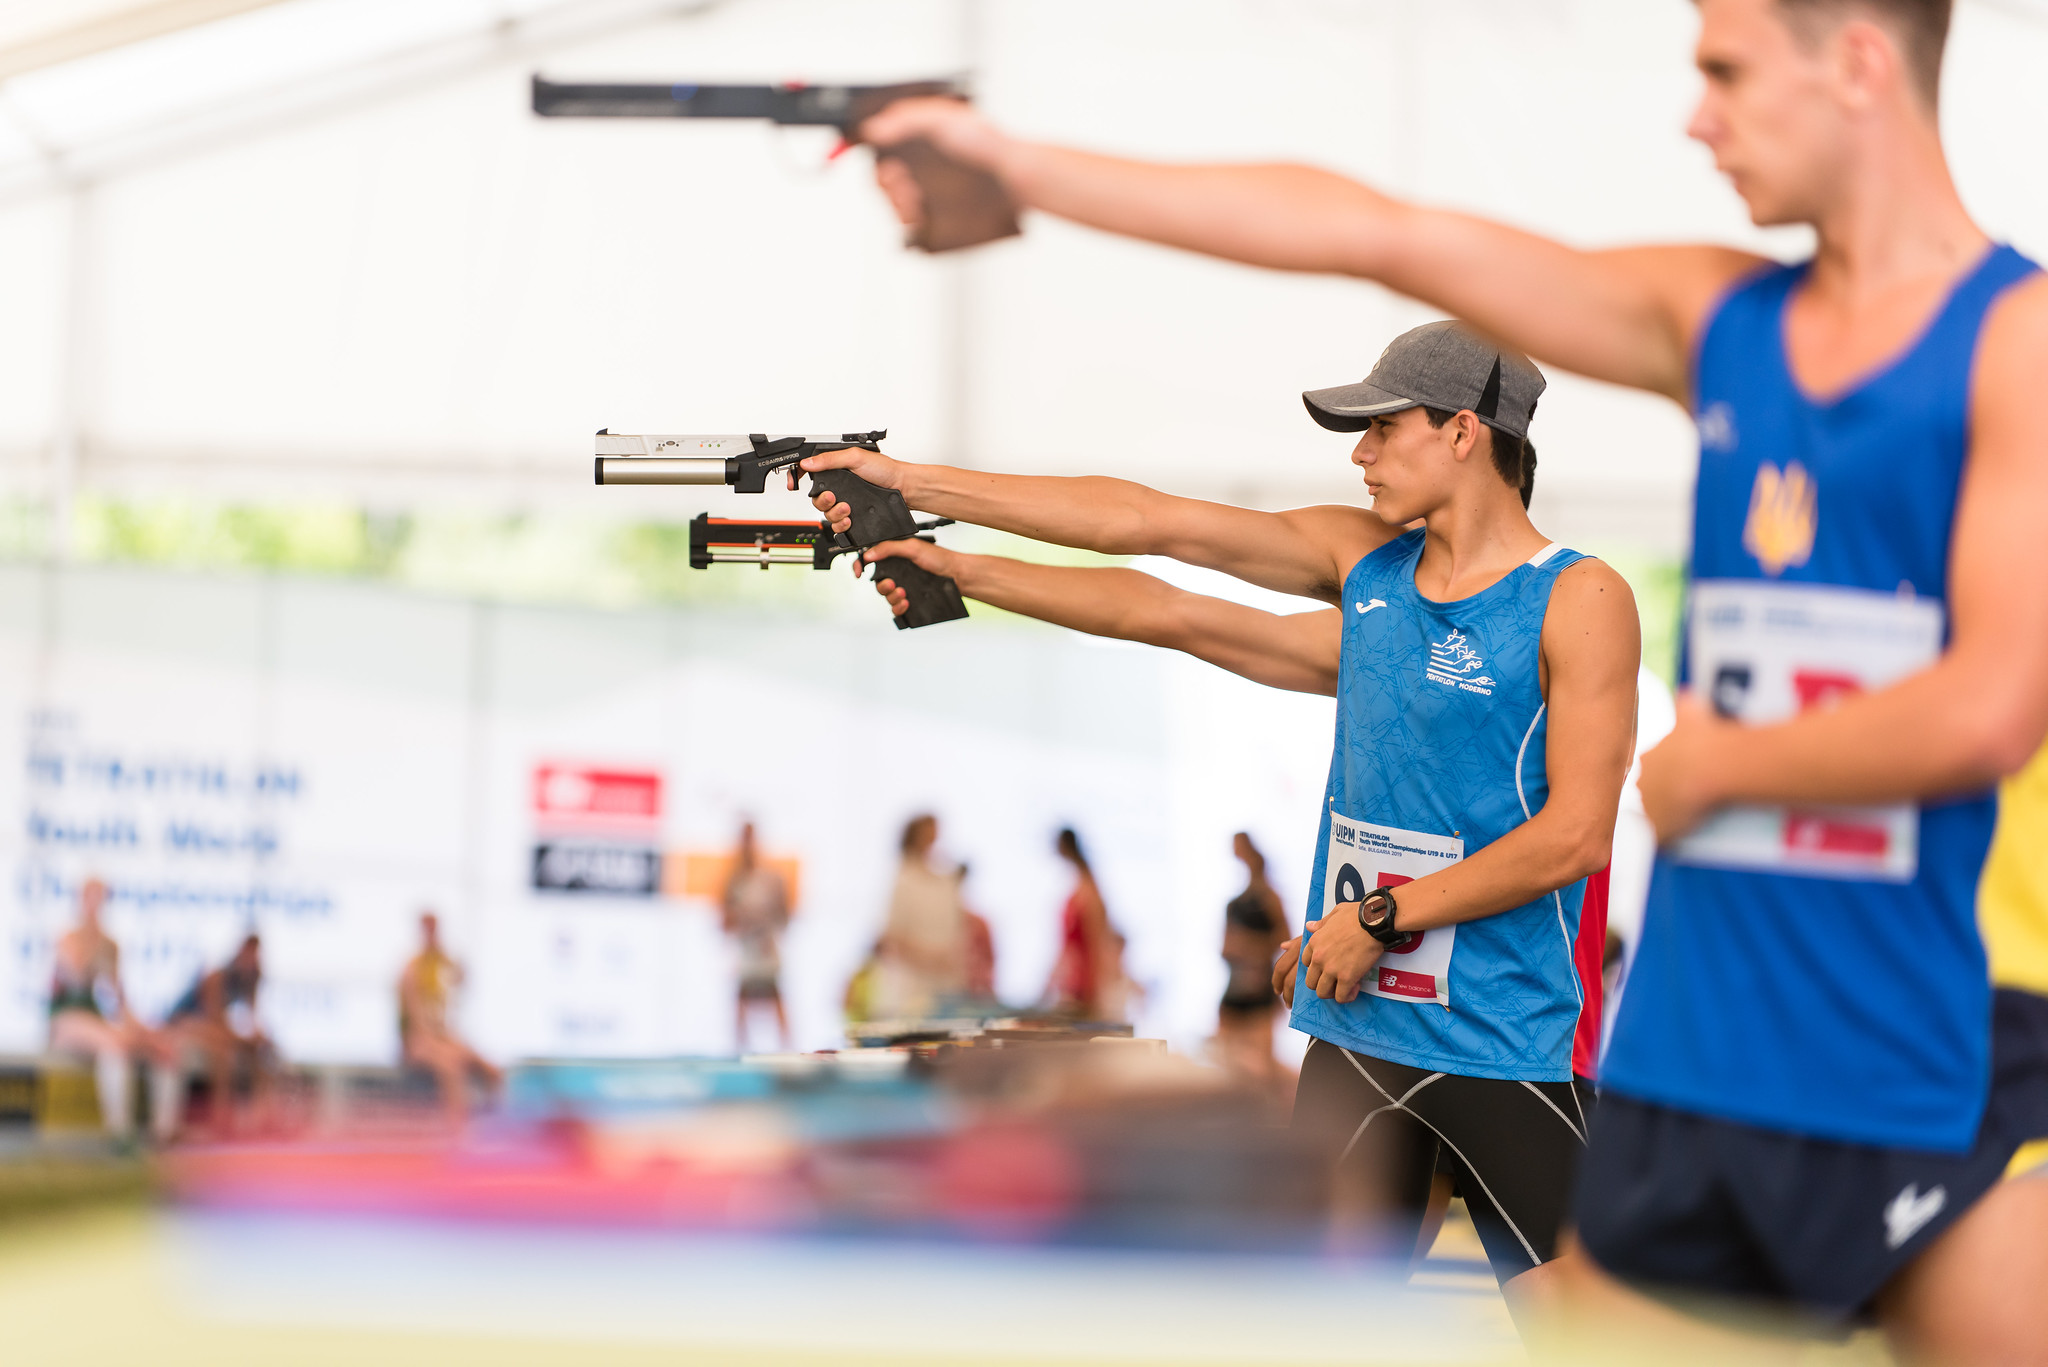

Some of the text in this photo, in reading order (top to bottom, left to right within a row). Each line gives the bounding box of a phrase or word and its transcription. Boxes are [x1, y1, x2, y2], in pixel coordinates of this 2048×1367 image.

[1425, 672, 1492, 696] PENTATLON MODERNO
[1336, 823, 1355, 842] UIPM
[1359, 830, 1390, 842] TETRATHLON
[1359, 837, 1371, 846] Youth
[1372, 840, 1388, 849] World
[1388, 842, 1427, 855] Championships
[1427, 849, 1439, 857] U19
[1408, 984, 1432, 993] balance
